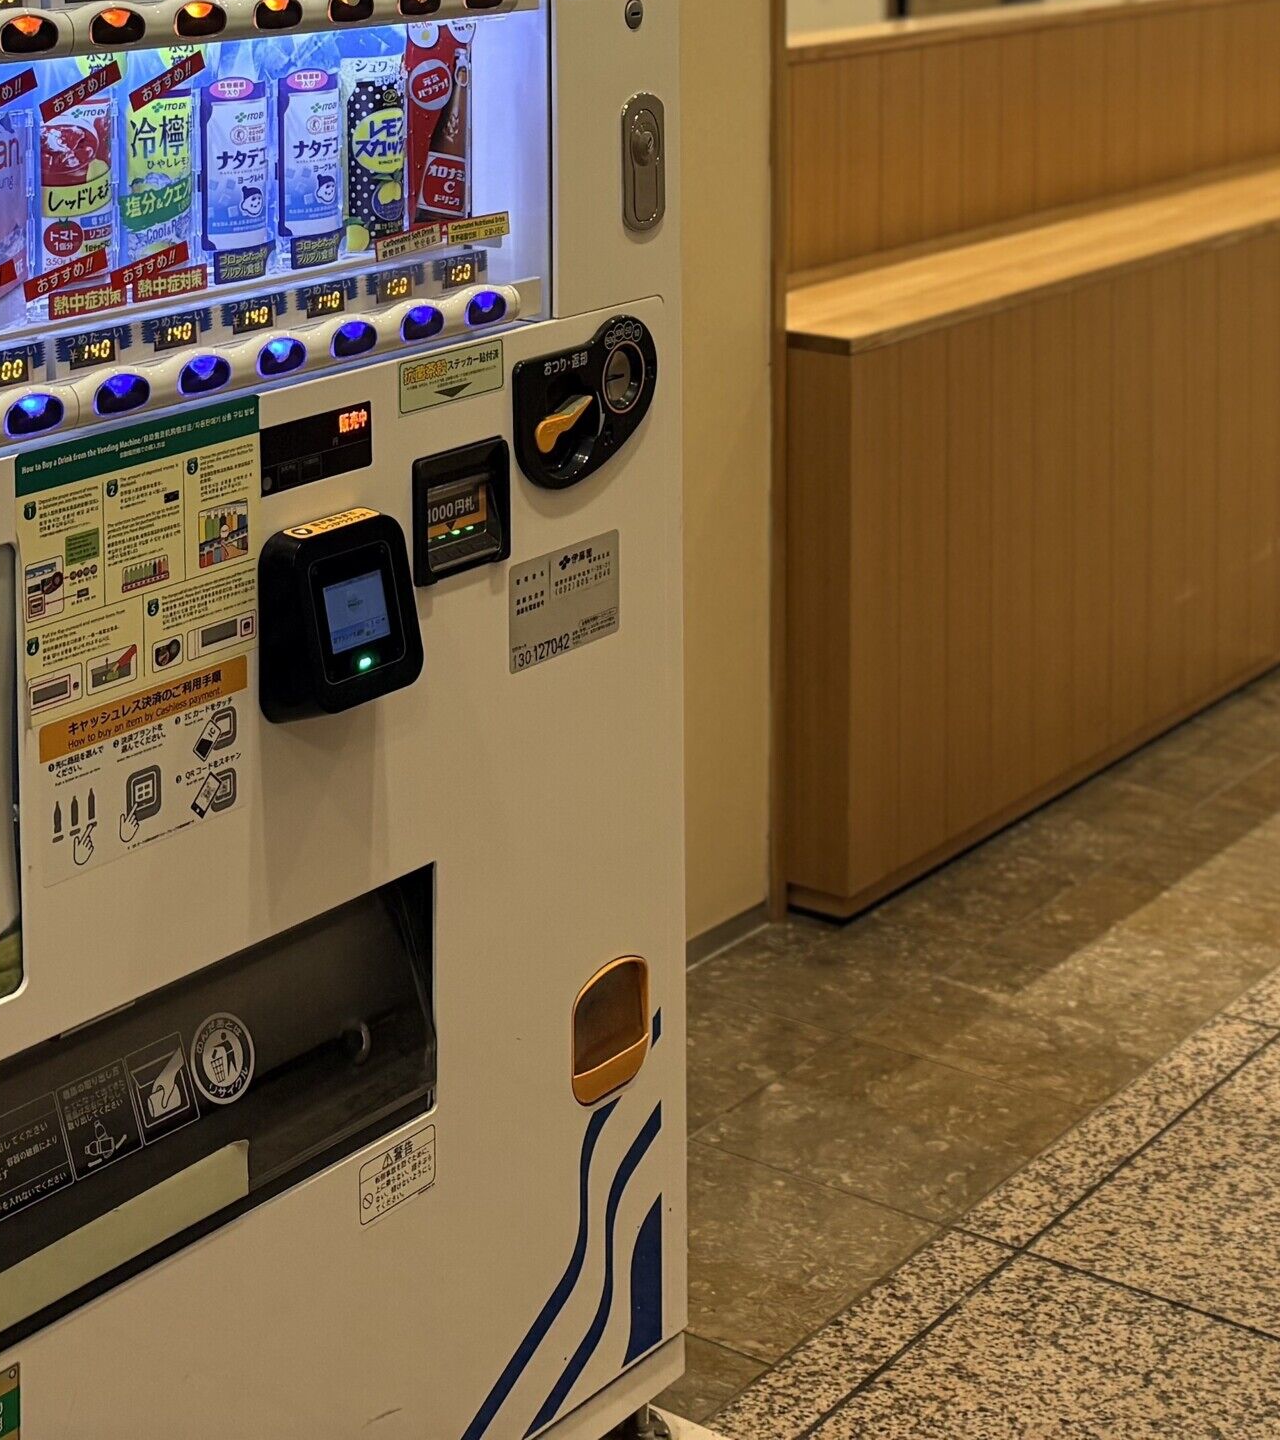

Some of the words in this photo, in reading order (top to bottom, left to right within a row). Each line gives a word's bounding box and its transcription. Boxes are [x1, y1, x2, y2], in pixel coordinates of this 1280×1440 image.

[50, 231, 78, 242] トマト
[138, 269, 203, 298] 熱中症対策
[54, 289, 122, 314] 熱中症対策
[338, 410, 367, 433] 販売中
[427, 495, 475, 524] 1000円札
[206, 1067, 249, 1099] リサイクル
